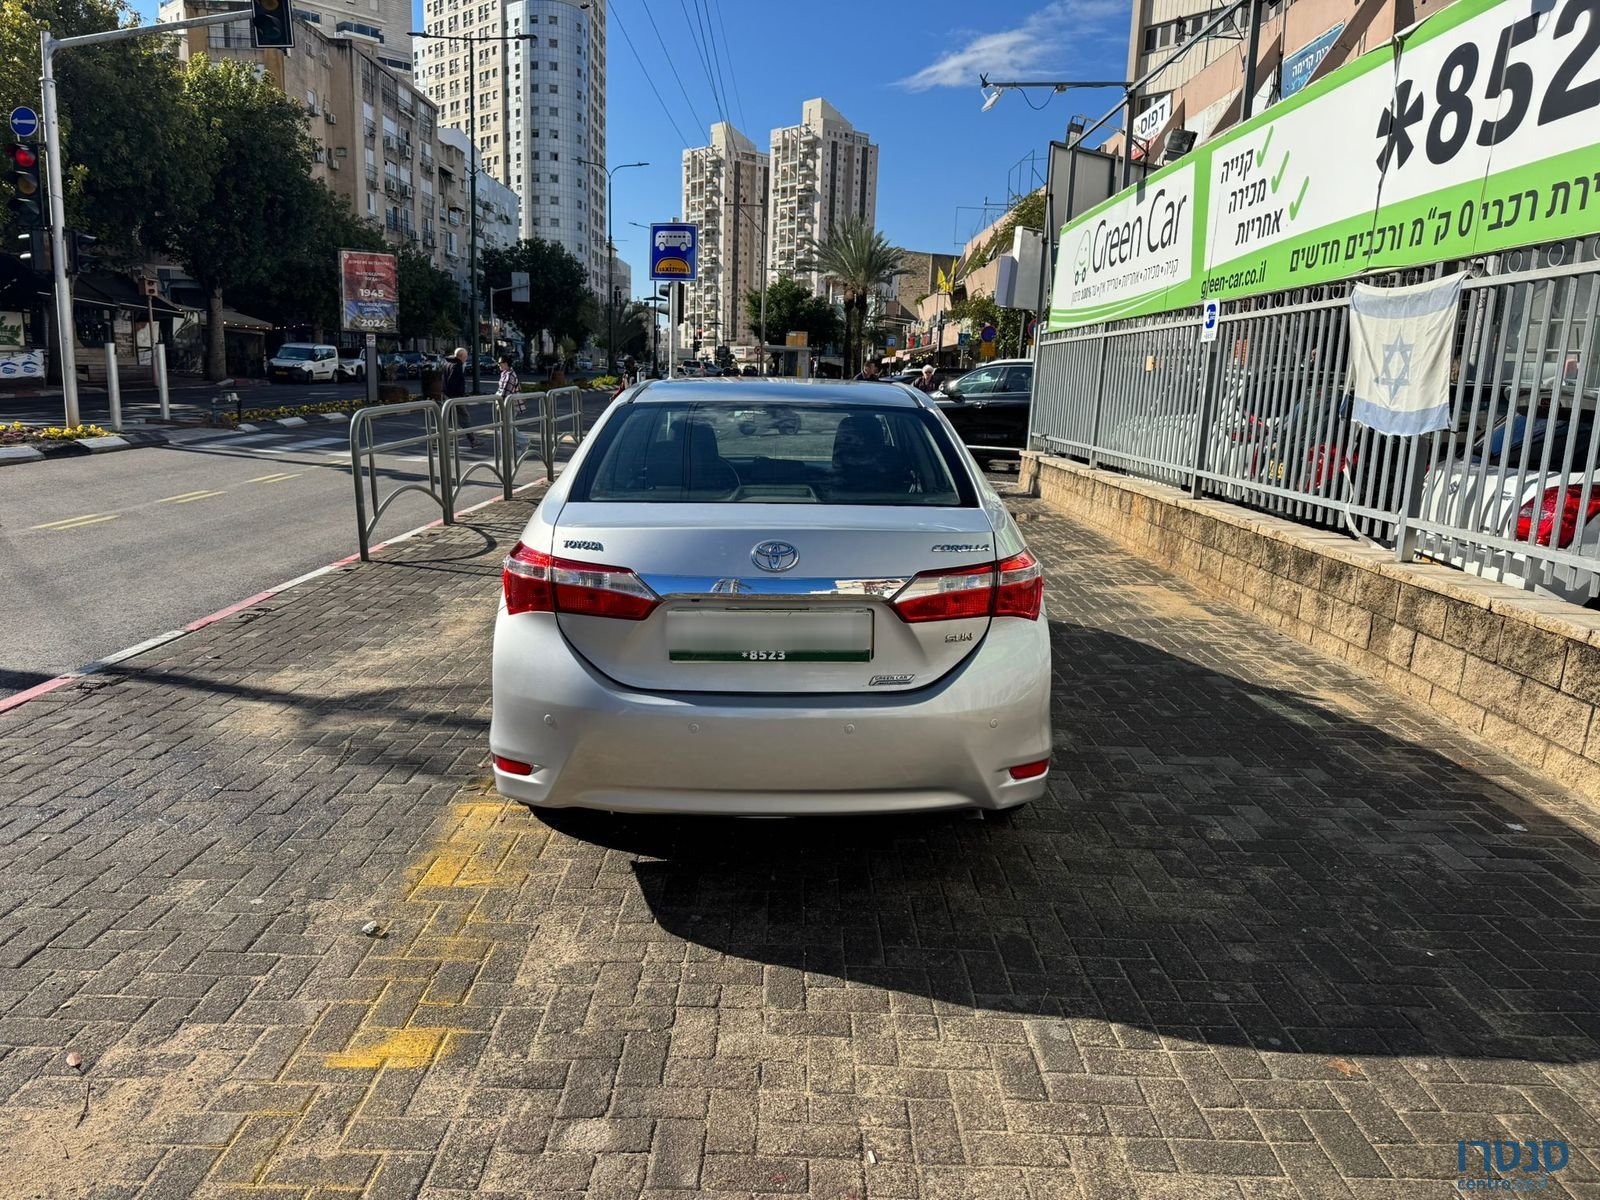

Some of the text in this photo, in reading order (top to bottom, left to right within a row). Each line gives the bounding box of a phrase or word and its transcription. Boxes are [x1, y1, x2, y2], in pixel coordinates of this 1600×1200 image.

[1292, 54, 1314, 78] קדימה
[1140, 104, 1165, 135] דפוס
[1221, 148, 1254, 184] קנייה
[1228, 178, 1267, 214] מכירה
[1482, 189, 1539, 232] רכבי
[1092, 188, 1187, 274] Green Car
[1235, 208, 1284, 246] אחריות
[1458, 200, 1475, 237] 0
[1289, 239, 1341, 272] חדשים
[1344, 222, 1405, 261] ורכבים
[359, 288, 384, 298] 1945
[1201, 260, 1267, 299] green-car.co.il
[361, 319, 387, 328] 2024
[563, 540, 604, 552] TOYOTA
[931, 544, 990, 553] COROLLA
